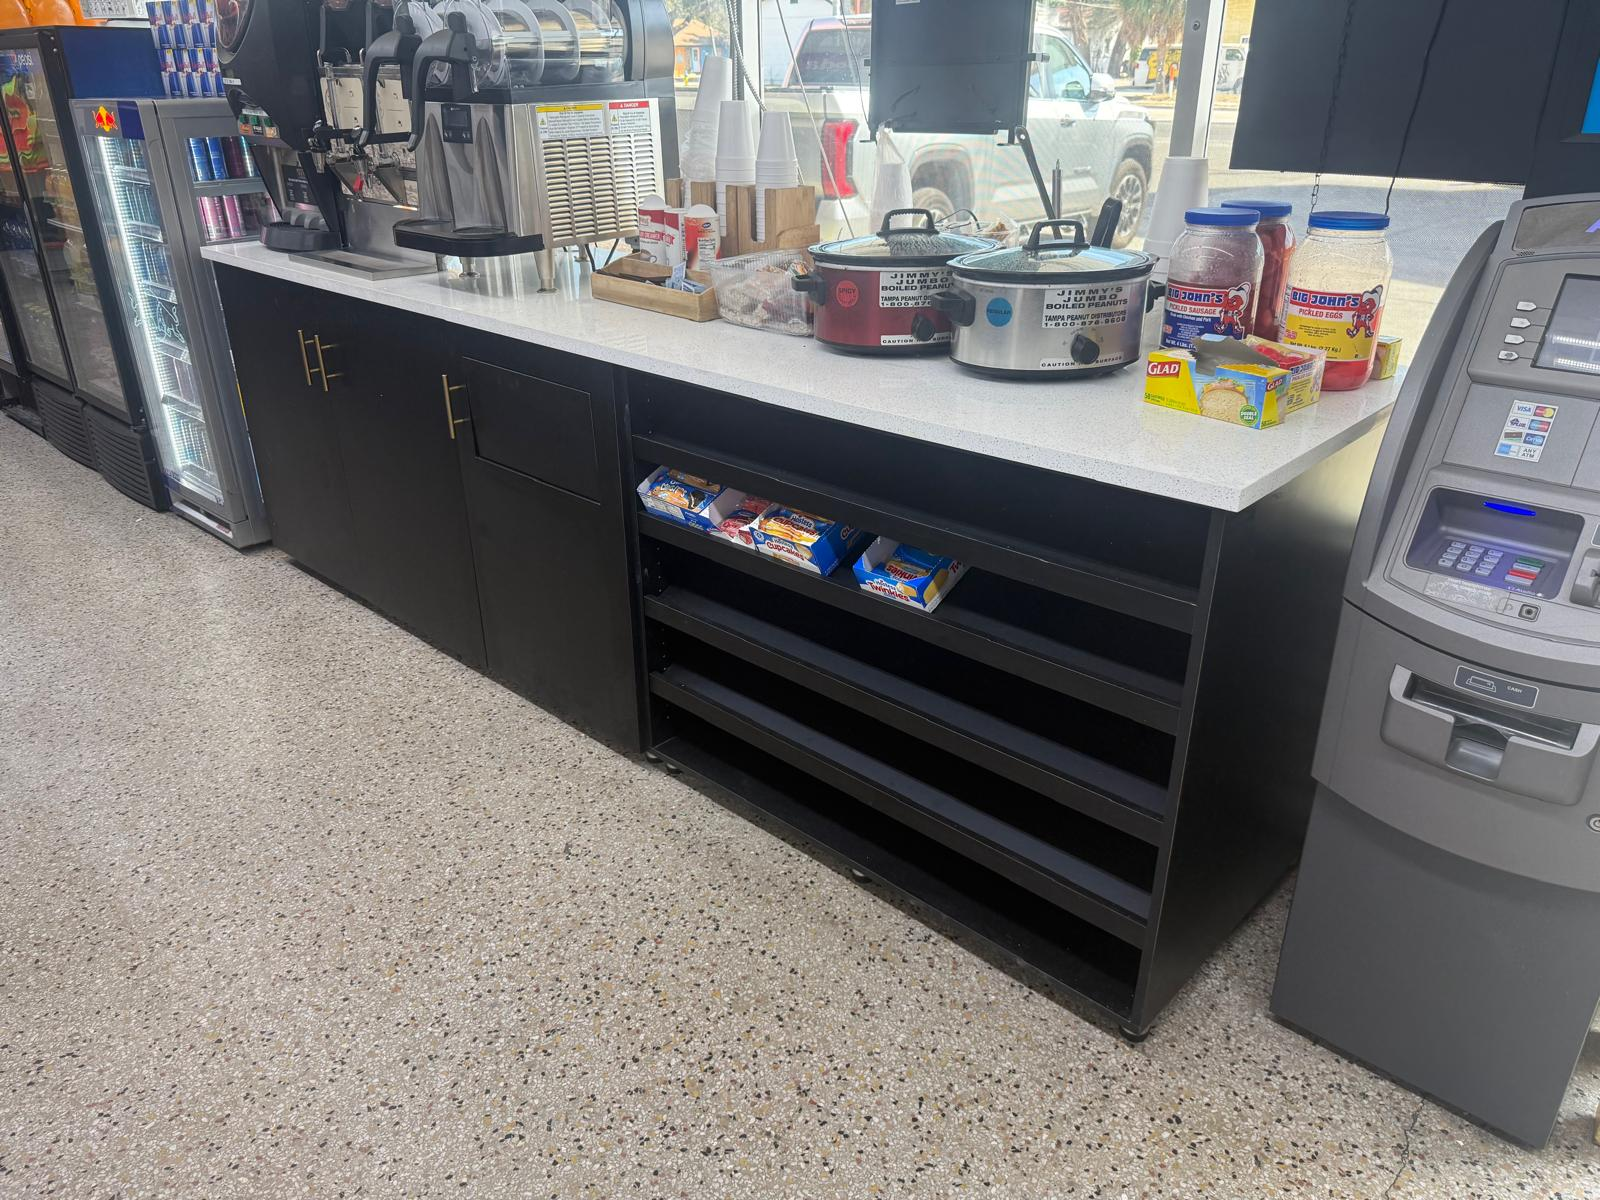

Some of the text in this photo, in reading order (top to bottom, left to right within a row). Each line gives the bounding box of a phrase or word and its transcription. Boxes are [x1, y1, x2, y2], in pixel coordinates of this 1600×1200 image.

[890, 271, 953, 279] JIMMY'S
[896, 277, 949, 285] JUMBO
[1057, 286, 1123, 296] JIMMY'S
[1291, 290, 1309, 302] BIG
[1063, 293, 1118, 302] JUMBO
[1088, 298, 1128, 308] PEANUTS
[1169, 302, 1217, 315] PICKLED SAUSAGE
[1299, 307, 1344, 319] PICKLED EGGS
[1067, 313, 1090, 321] PEANUT
[1091, 310, 1127, 319] DISTRIBUTORS
[1147, 362, 1180, 375] GLAD
[1267, 379, 1283, 390] GLAD
[791, 514, 813, 528] Hostess
[766, 541, 804, 561] Cupcakes
[866, 581, 910, 602] Twinkies
